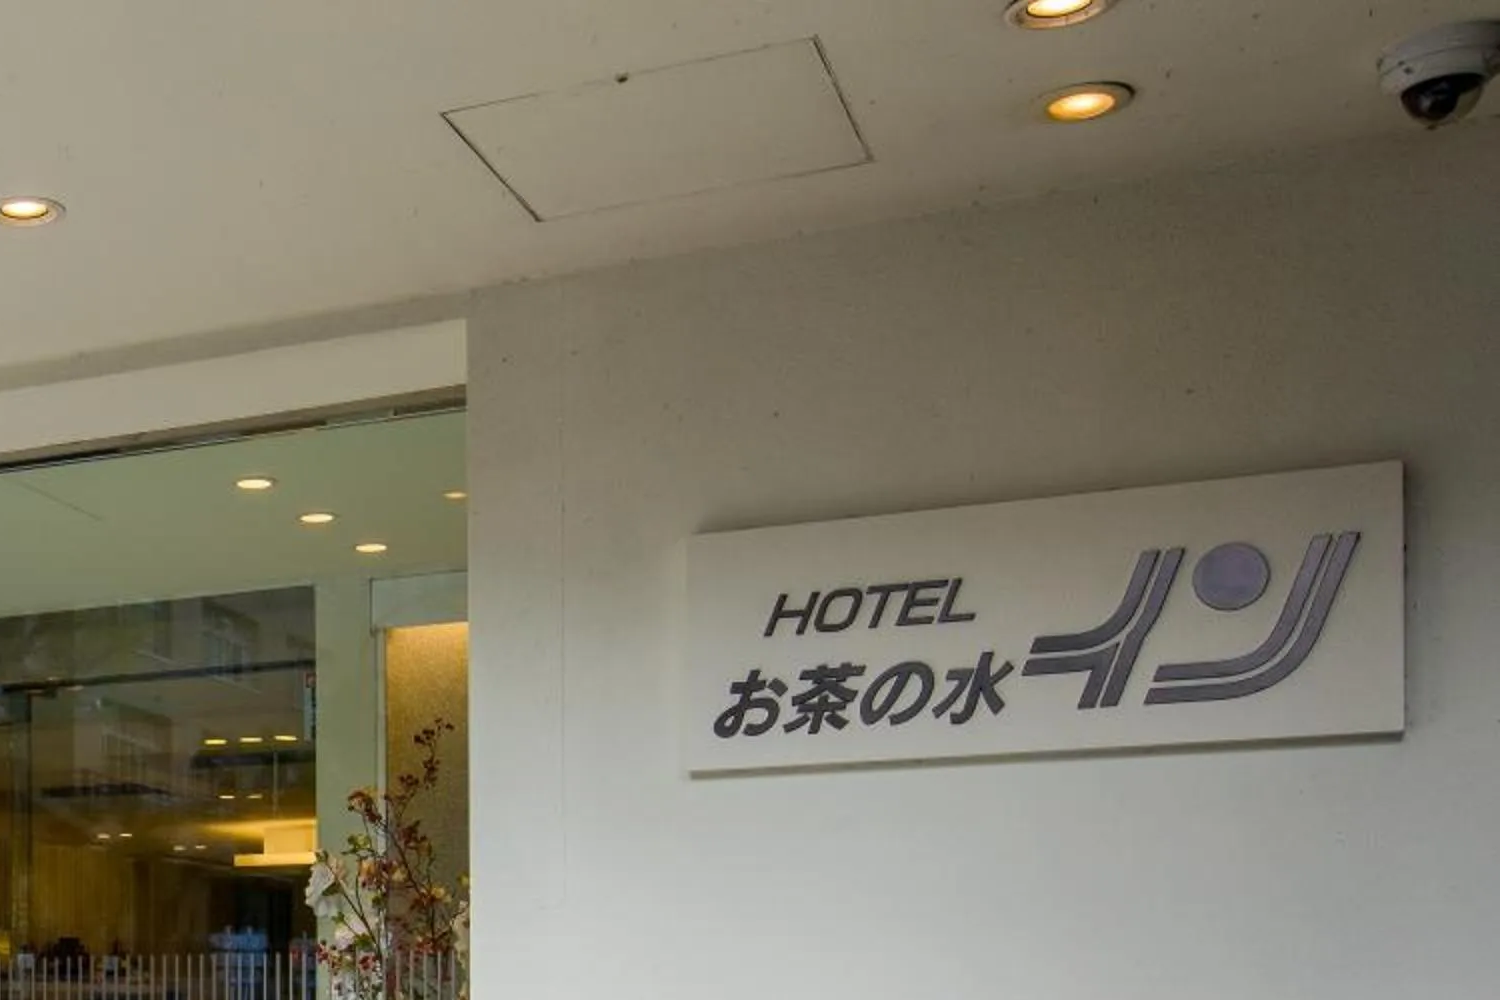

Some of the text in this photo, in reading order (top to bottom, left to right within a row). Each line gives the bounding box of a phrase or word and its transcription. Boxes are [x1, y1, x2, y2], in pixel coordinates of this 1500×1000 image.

[764, 578, 977, 638] HOTEL
[713, 652, 1015, 739] お茶の水
